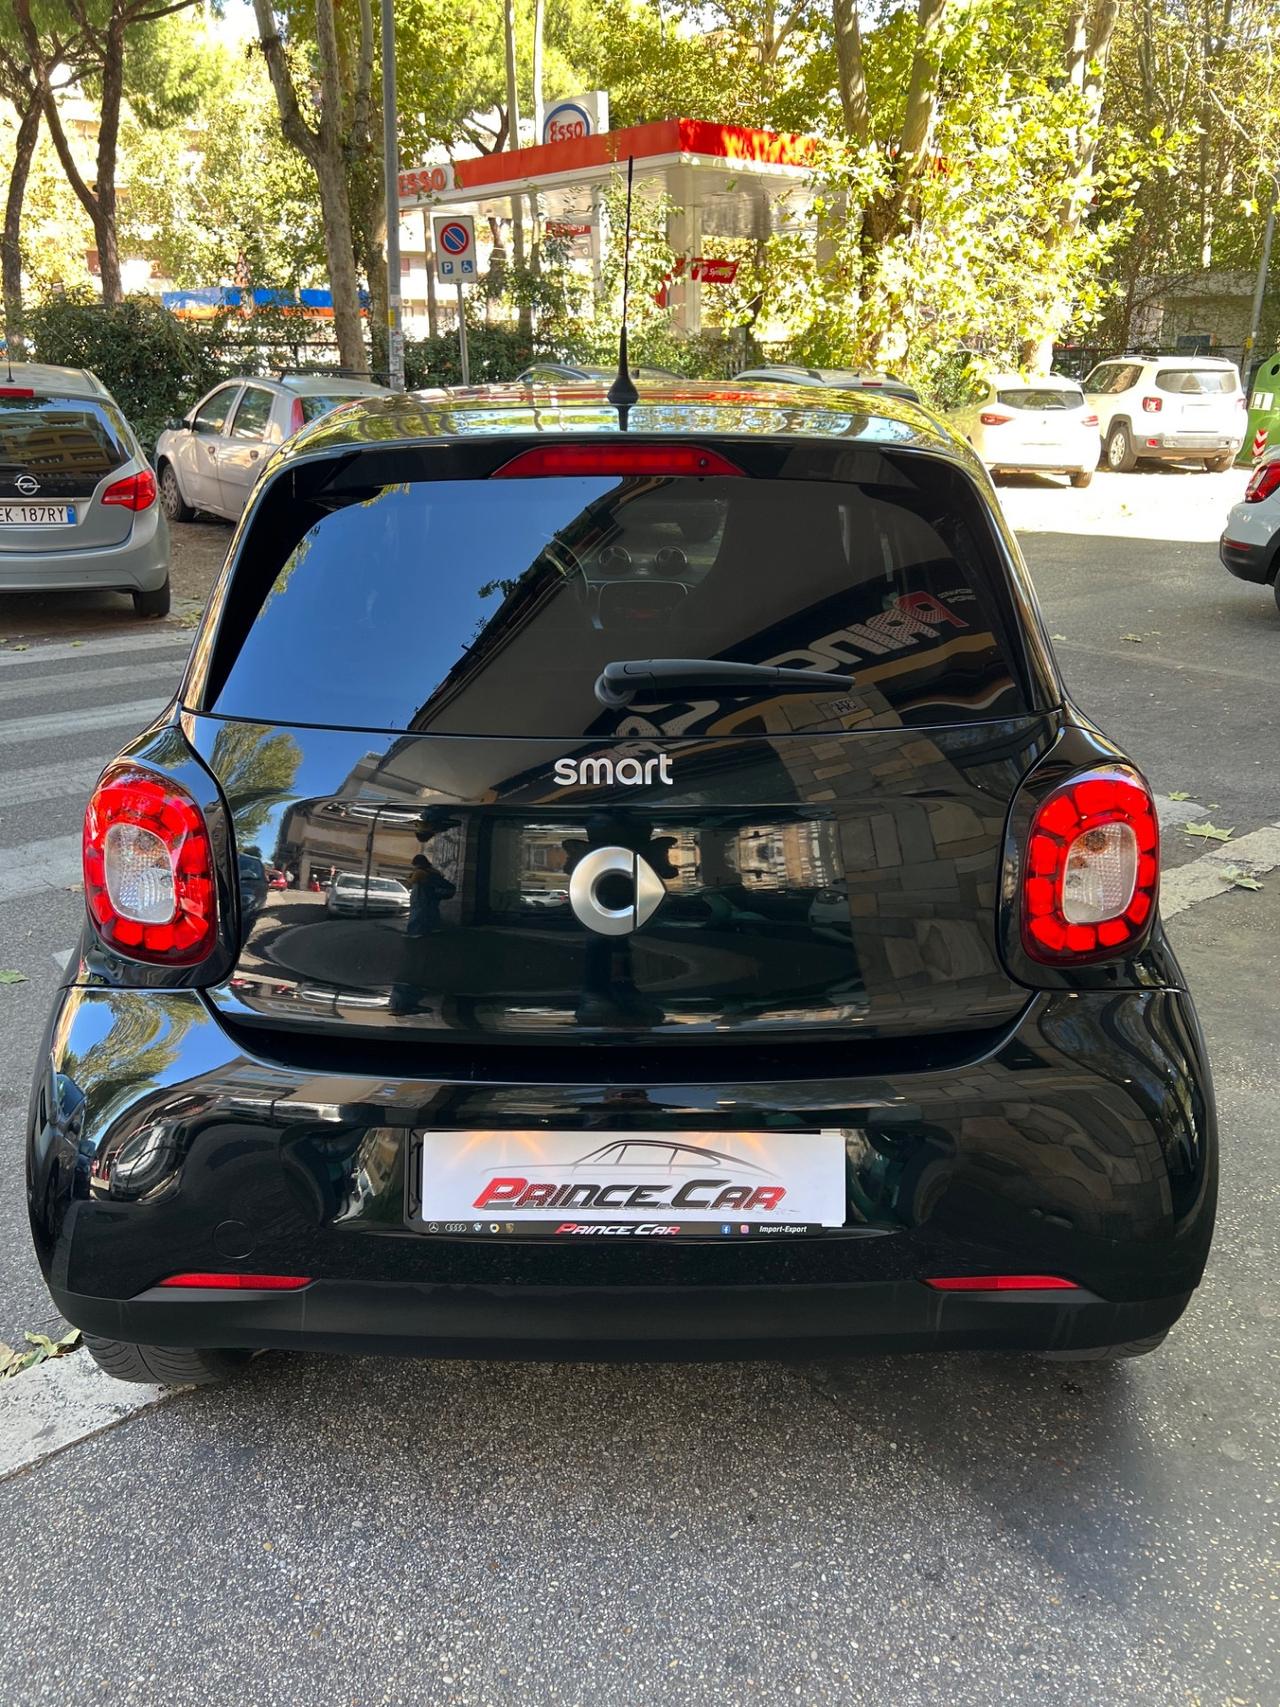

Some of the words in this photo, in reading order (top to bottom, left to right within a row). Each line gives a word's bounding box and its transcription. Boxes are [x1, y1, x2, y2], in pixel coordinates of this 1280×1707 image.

[21, 507, 64, 522] 187RY
[553, 753, 674, 786] smart
[472, 1177, 673, 1211] PRINCE
[671, 1179, 787, 1211] CAR
[554, 1223, 636, 1235] PRINCE
[634, 1223, 681, 1236] CAR
[759, 1225, 808, 1235] Import-Export
